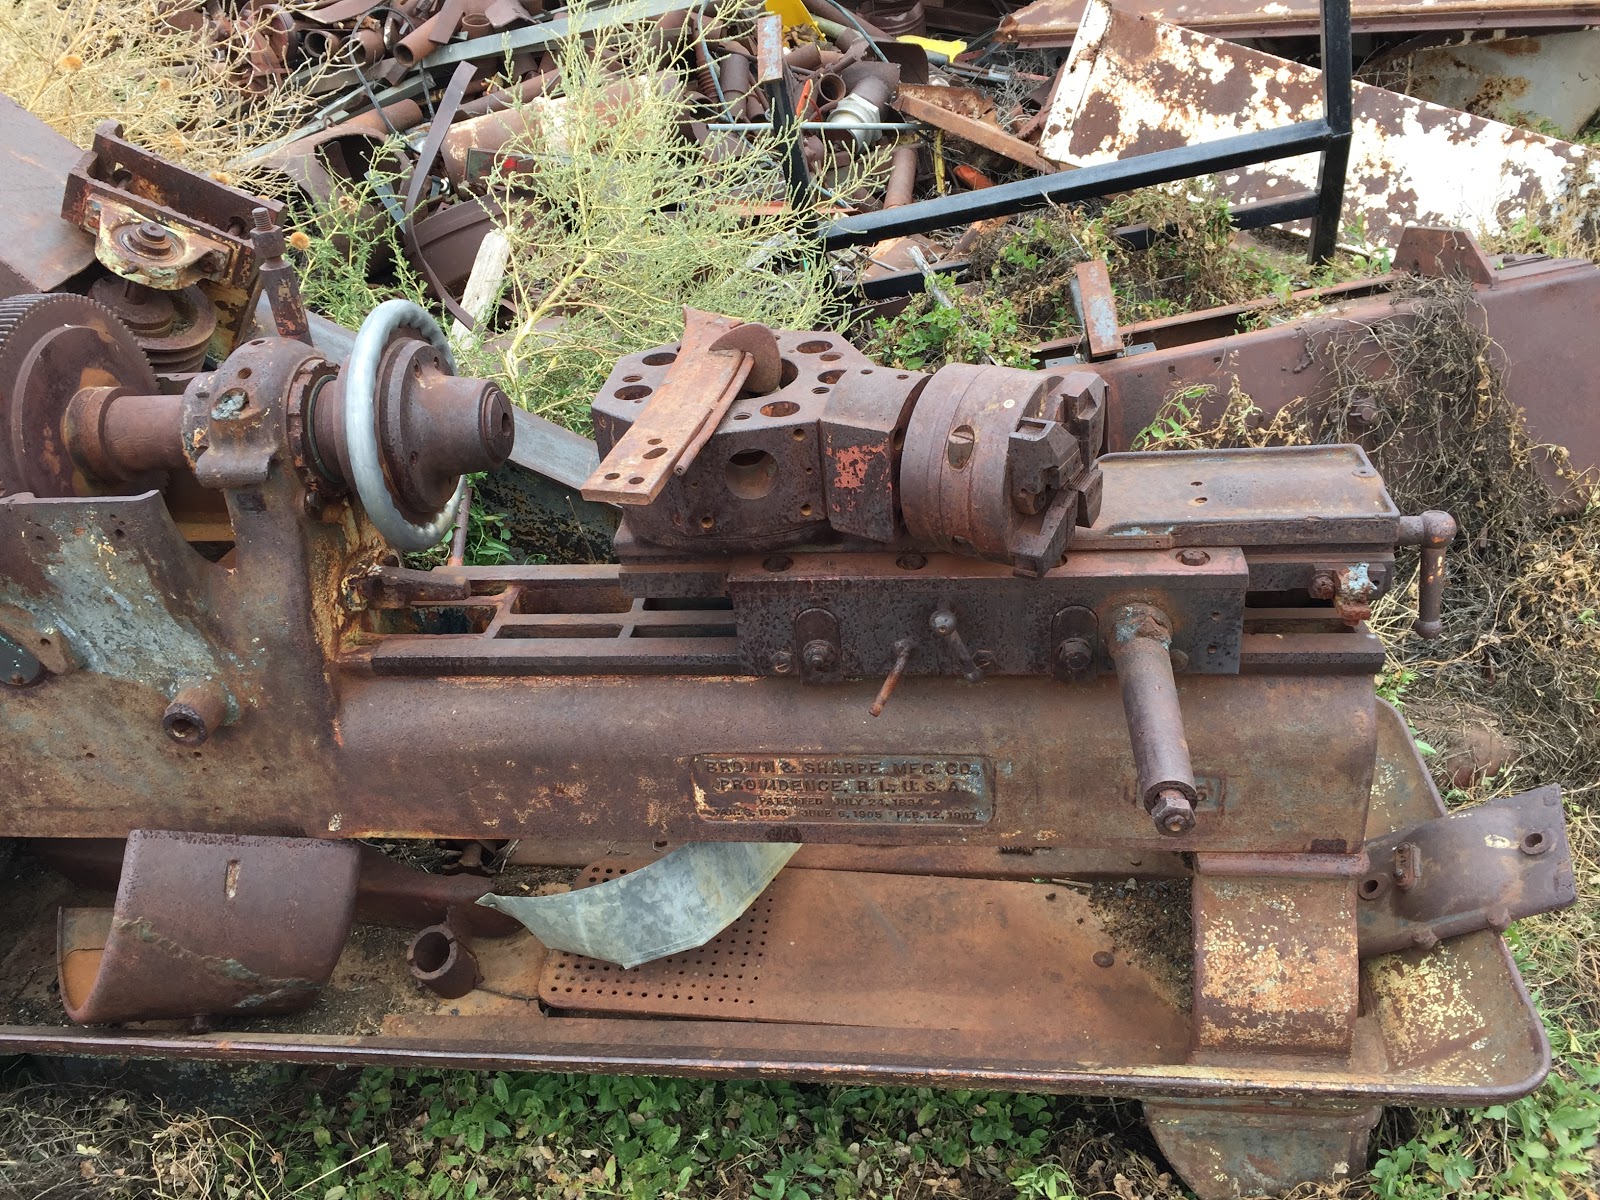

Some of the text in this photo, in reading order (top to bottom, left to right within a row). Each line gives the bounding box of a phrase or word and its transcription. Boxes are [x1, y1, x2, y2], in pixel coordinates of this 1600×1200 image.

[706, 761, 775, 774] BROWN
[782, 761, 797, 773] &
[803, 762, 882, 774] SHARPE
[892, 762, 940, 775] MFG.
[759, 797, 823, 806] PATENTED
[832, 797, 863, 806] JULY
[800, 809, 832, 818] JUNE
